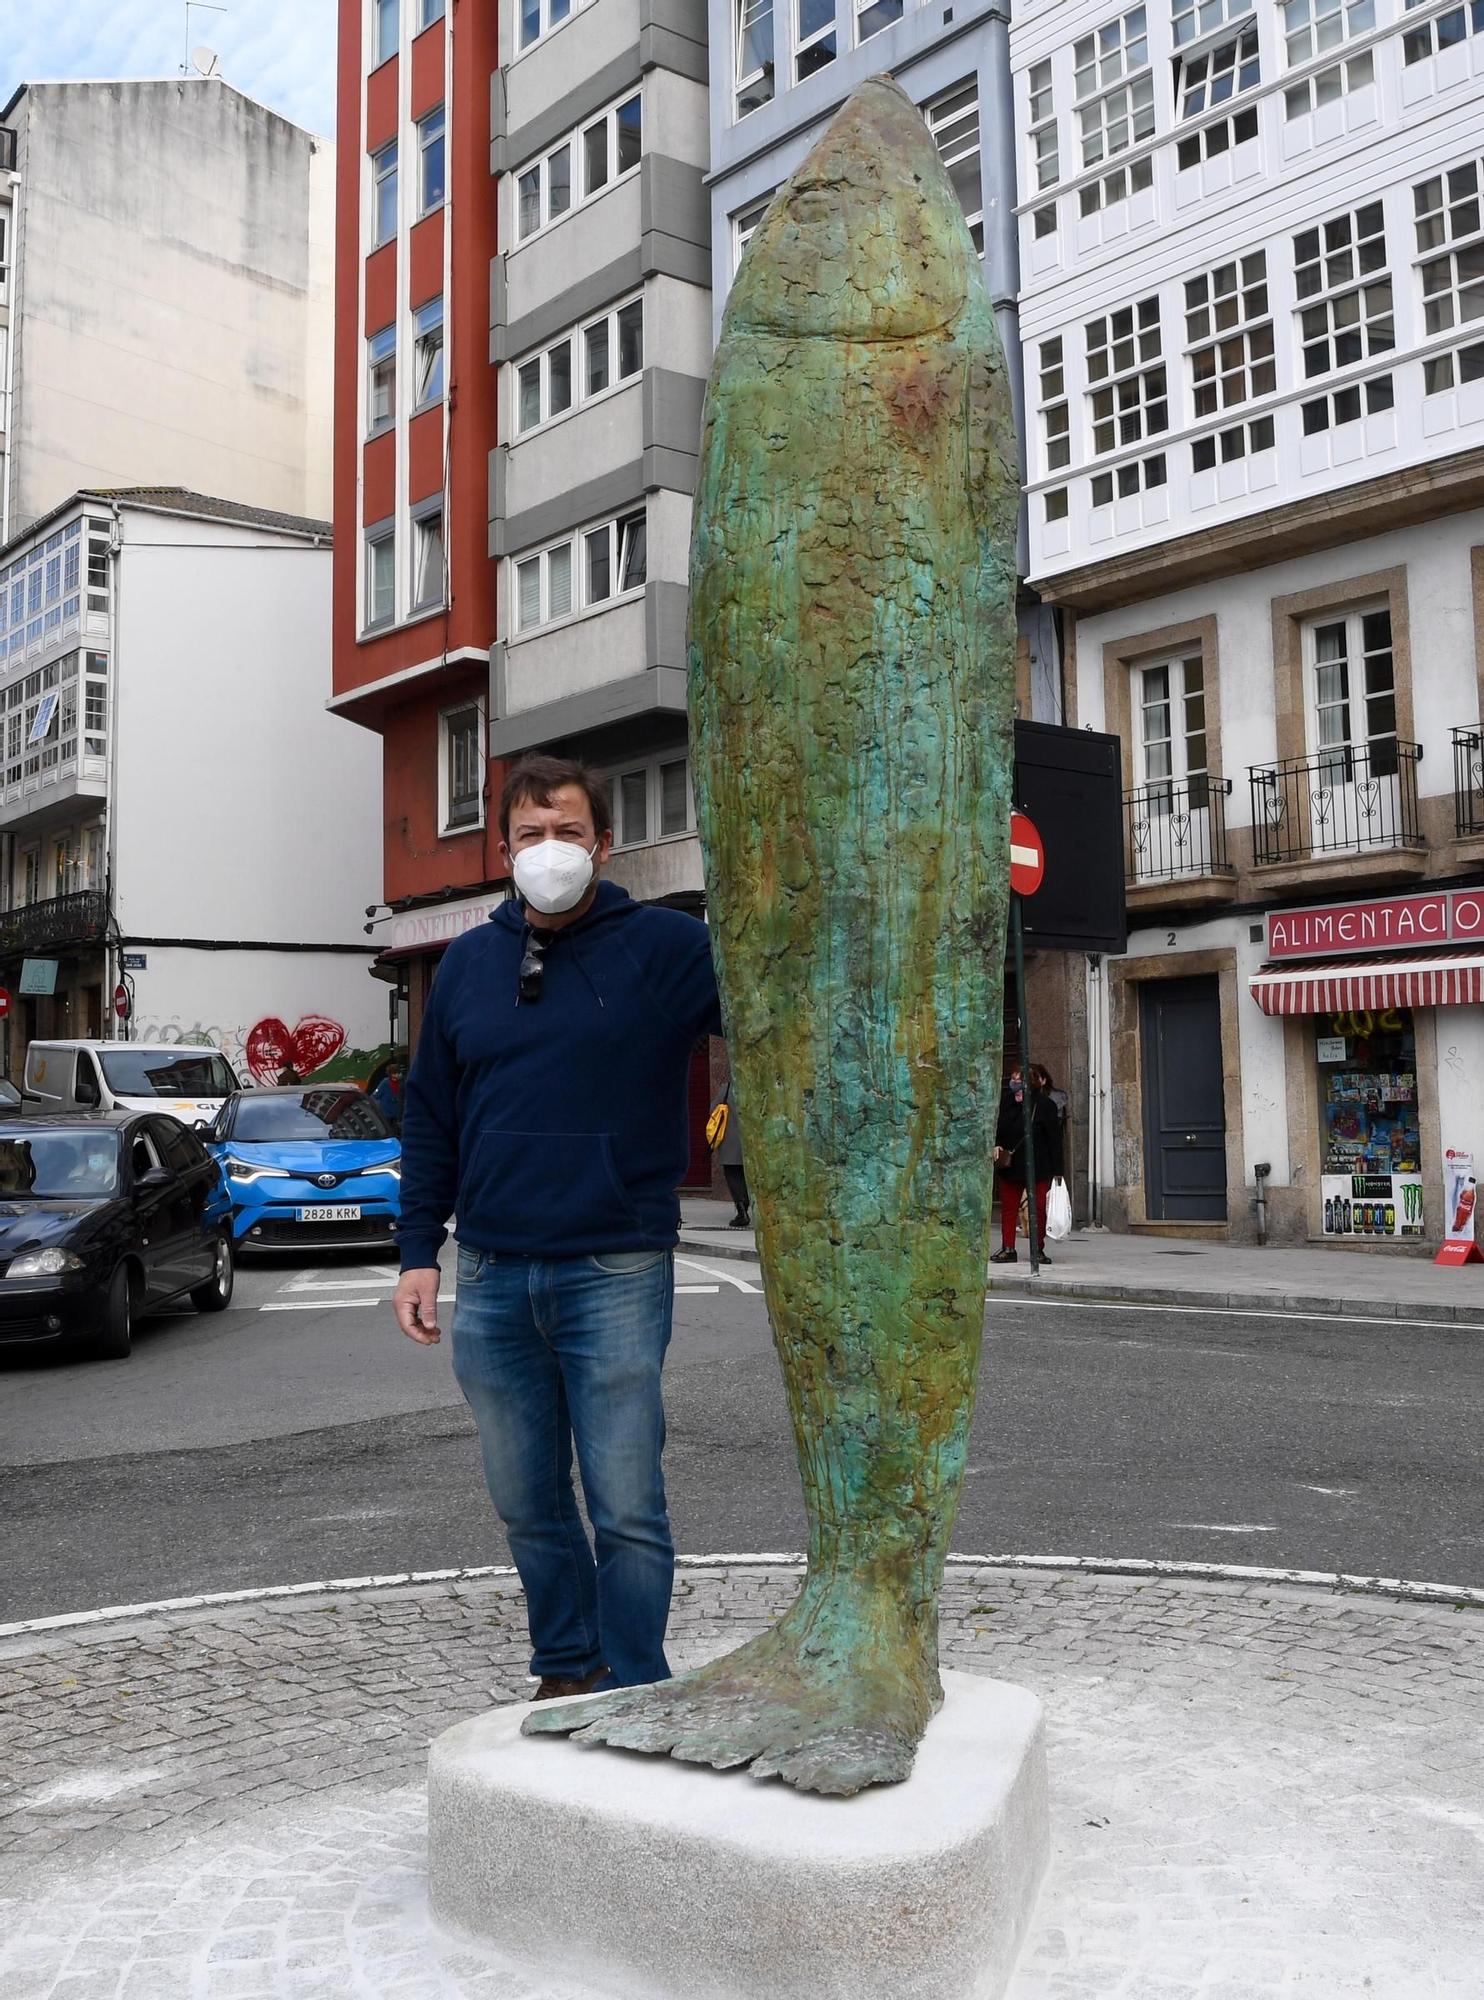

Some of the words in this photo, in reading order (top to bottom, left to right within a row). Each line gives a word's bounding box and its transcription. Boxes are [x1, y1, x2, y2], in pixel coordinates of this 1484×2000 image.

[1272, 900, 1481, 948] ALIMENTACIO
[1166, 932, 1177, 946] 2
[304, 1208, 333, 1220] 2828
[336, 1207, 358, 1219] KRK
